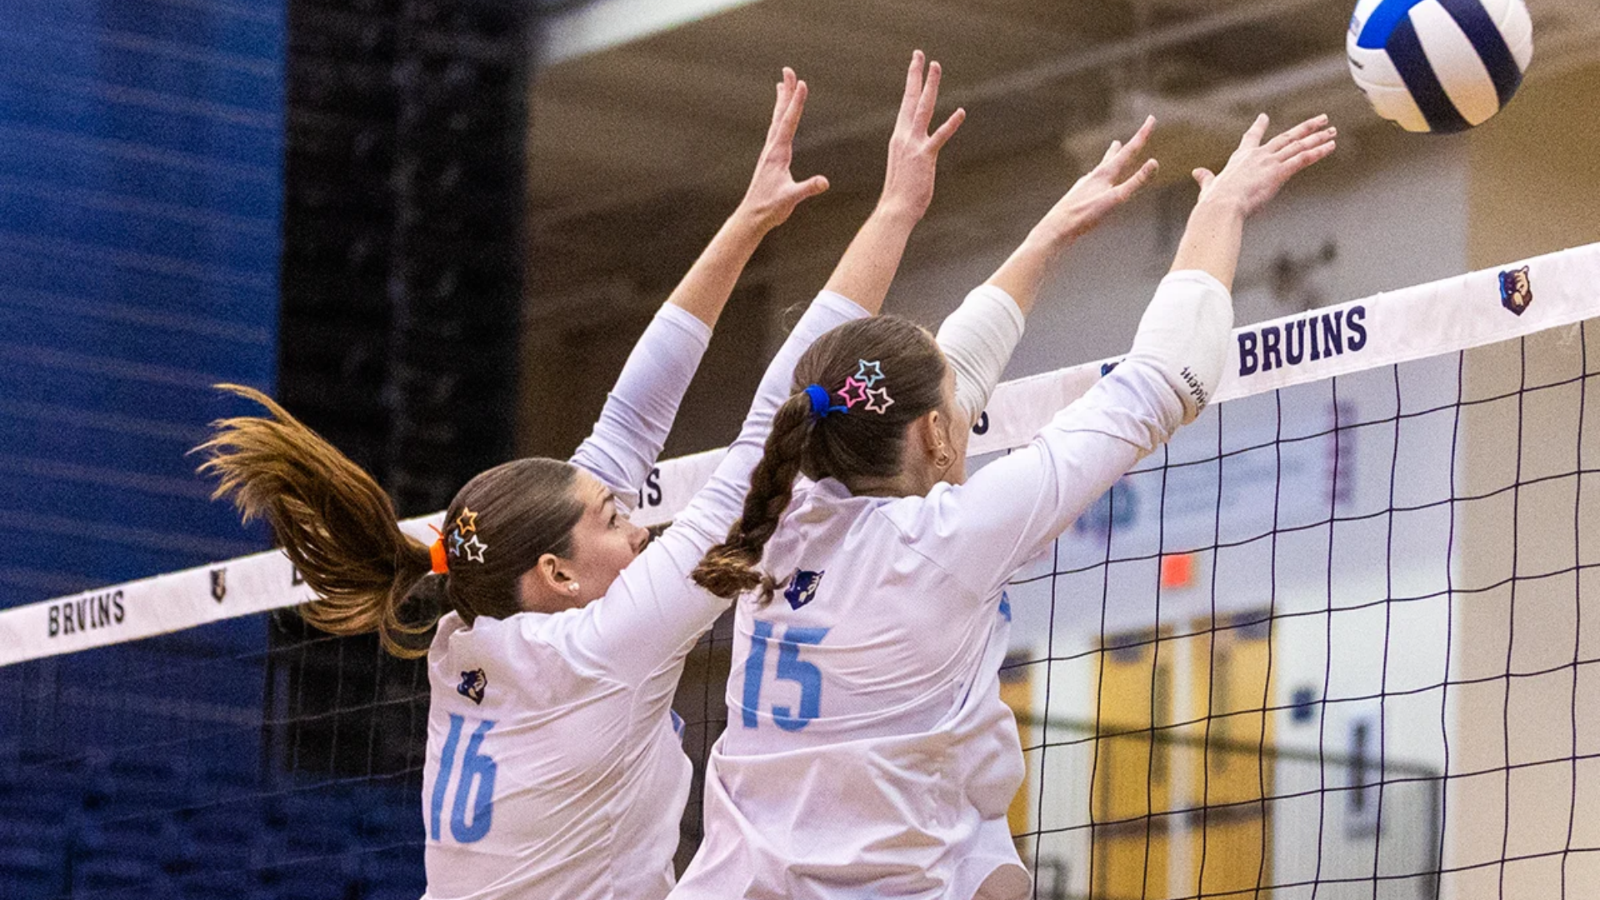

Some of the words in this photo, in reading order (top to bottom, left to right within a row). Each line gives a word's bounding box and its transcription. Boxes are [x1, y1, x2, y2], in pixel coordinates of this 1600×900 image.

[1237, 305, 1367, 377] BRUINS
[48, 590, 125, 637] BRUINS
[742, 620, 830, 732] 15
[430, 713, 497, 843] 16
